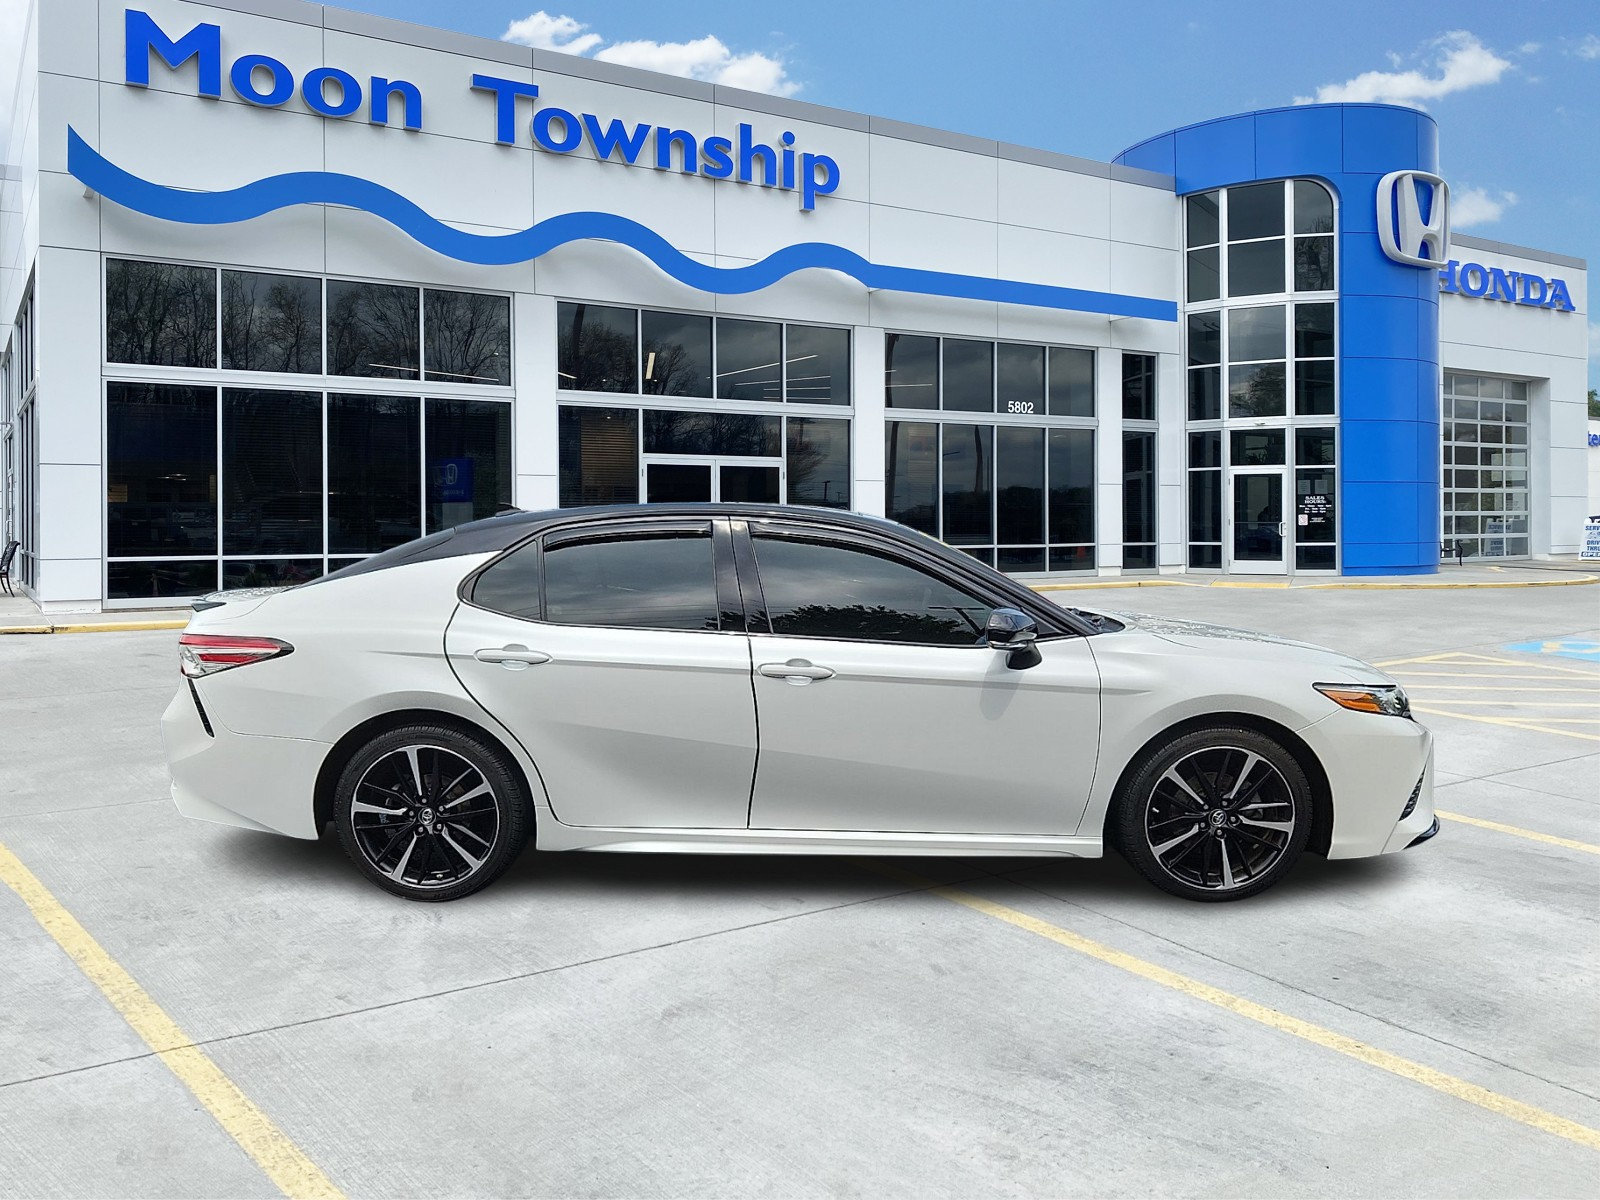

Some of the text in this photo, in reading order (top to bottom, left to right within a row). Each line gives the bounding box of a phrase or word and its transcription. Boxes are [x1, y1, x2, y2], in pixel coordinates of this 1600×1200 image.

[124, 8, 840, 212] Moon Township
[1007, 400, 1034, 414] 5802
